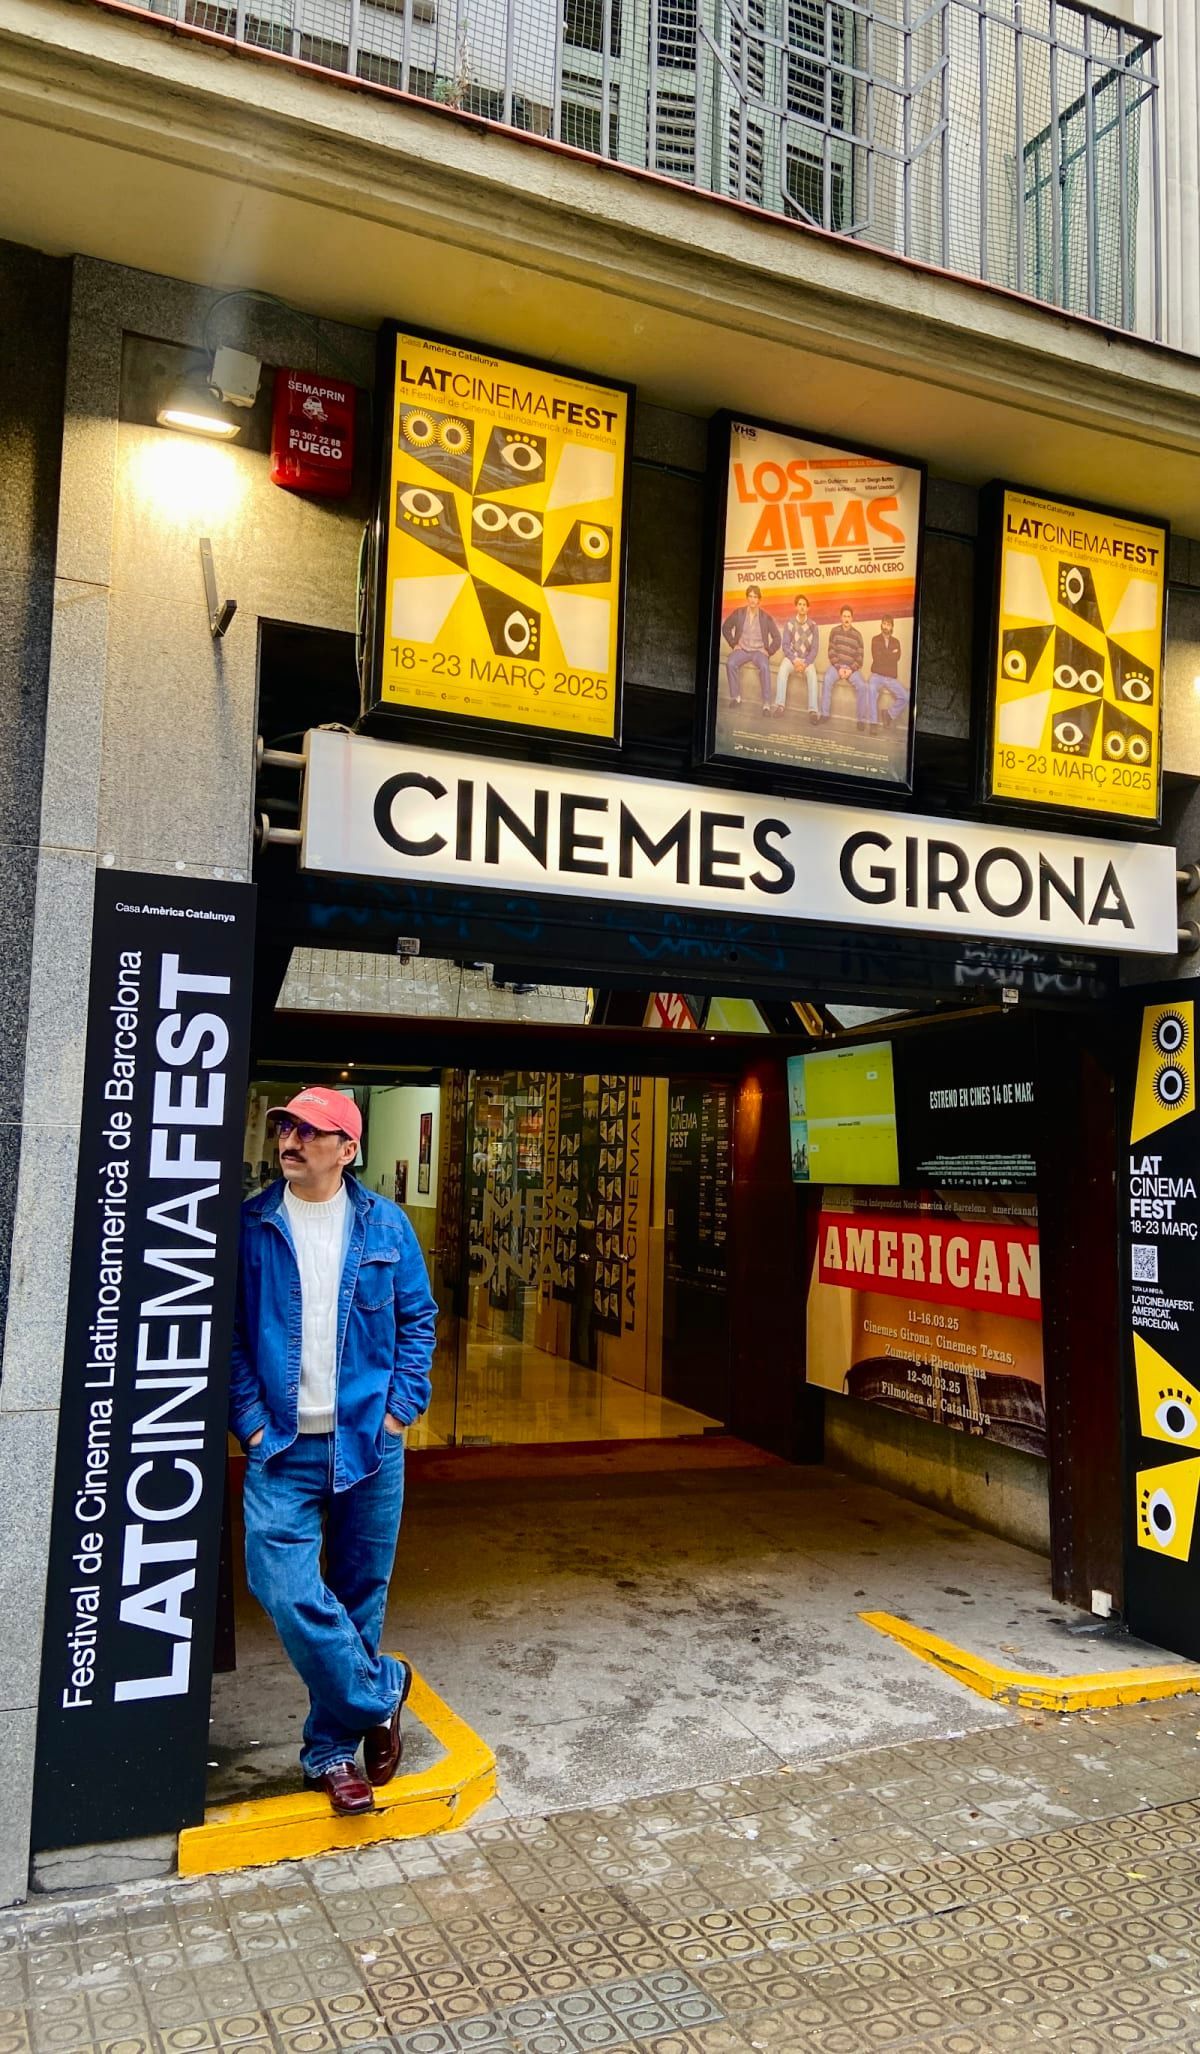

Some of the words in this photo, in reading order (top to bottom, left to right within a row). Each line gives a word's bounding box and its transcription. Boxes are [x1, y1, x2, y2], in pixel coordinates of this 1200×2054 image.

[458, 351, 499, 368] Catalunya
[288, 380, 345, 402] SEMAPRIN
[400, 359, 618, 433] LATCINEMAFEST
[411, 387, 446, 404] Festival
[447, 397, 460, 408] de
[462, 400, 496, 417] Cinema
[562, 426, 573, 434] de
[575, 428, 617, 446] Barcelona
[733, 423, 757, 437] VHS
[289, 428, 300, 438] 93
[302, 431, 317, 441] 307
[289, 437, 342, 460] FUEGO
[733, 460, 813, 503] LOS
[746, 496, 906, 552] AITAS
[1007, 514, 1159, 566] LATCINEMAFEST
[738, 571, 767, 583] PADRE
[768, 567, 825, 581] OCHENTERO,
[825, 562, 880, 577] IMPLICACIÓN
[882, 562, 905, 573] CERO
[470, 658, 546, 696] MARÇ
[553, 672, 608, 701] 2025
[1052, 758, 1107, 788] MARÇ
[1112, 768, 1152, 790] 2025
[373, 772, 796, 896] CINEMES
[838, 830, 1136, 929] GIRONA
[115, 902, 141, 914] Casa
[141, 904, 185, 918] Amèrica
[185, 908, 236, 923] Catalunya
[104, 950, 142, 1101] Barcelona
[671, 1095, 685, 1113] LAT
[929, 1088, 958, 1109] ESTRENO
[958, 1088, 969, 1107] EN
[969, 1085, 991, 1106] CINES
[992, 1084, 1002, 1105] 14
[1003, 1083, 1013, 1104] DE
[102, 1111, 132, 1151] de
[670, 1112, 698, 1131] CINEMA
[669, 1131, 689, 1149] FEST
[1129, 1155, 1162, 1175] LAT
[1130, 1177, 1197, 1199] CINEMA
[944, 1201, 952, 1212] de
[953, 1202, 986, 1213] Barcelona
[1130, 1198, 1176, 1219] FEST
[1130, 1220, 1160, 1235] 18-23
[1161, 1222, 1198, 1240] MARÇ
[84, 1159, 130, 1388] Llatinoamericà
[823, 1226, 1041, 1300] AMERICAN
[1131, 1294, 1195, 1312] LATCINEMAFEST.
[1131, 1305, 1171, 1320] AMERICAT.
[114, 953, 231, 1702] LATCINEMAFEST
[1132, 1315, 1180, 1332] BARCELONA
[863, 1320, 898, 1338] Cinemes
[900, 1328, 933, 1347] Girona,
[936, 1334, 977, 1356] Cinemes
[980, 1343, 1016, 1366] Texas,
[884, 1343, 922, 1367] Zumzeig
[924, 1351, 930, 1367] i
[930, 1352, 987, 1380] Phenomena
[881, 1381, 925, 1405] Filmoteca
[926, 1391, 938, 1409] de
[940, 1398, 991, 1425] Catalunya
[75, 1398, 114, 1522] Cinema
[72, 1532, 104, 1575] de
[62, 1585, 101, 1709] Festival
